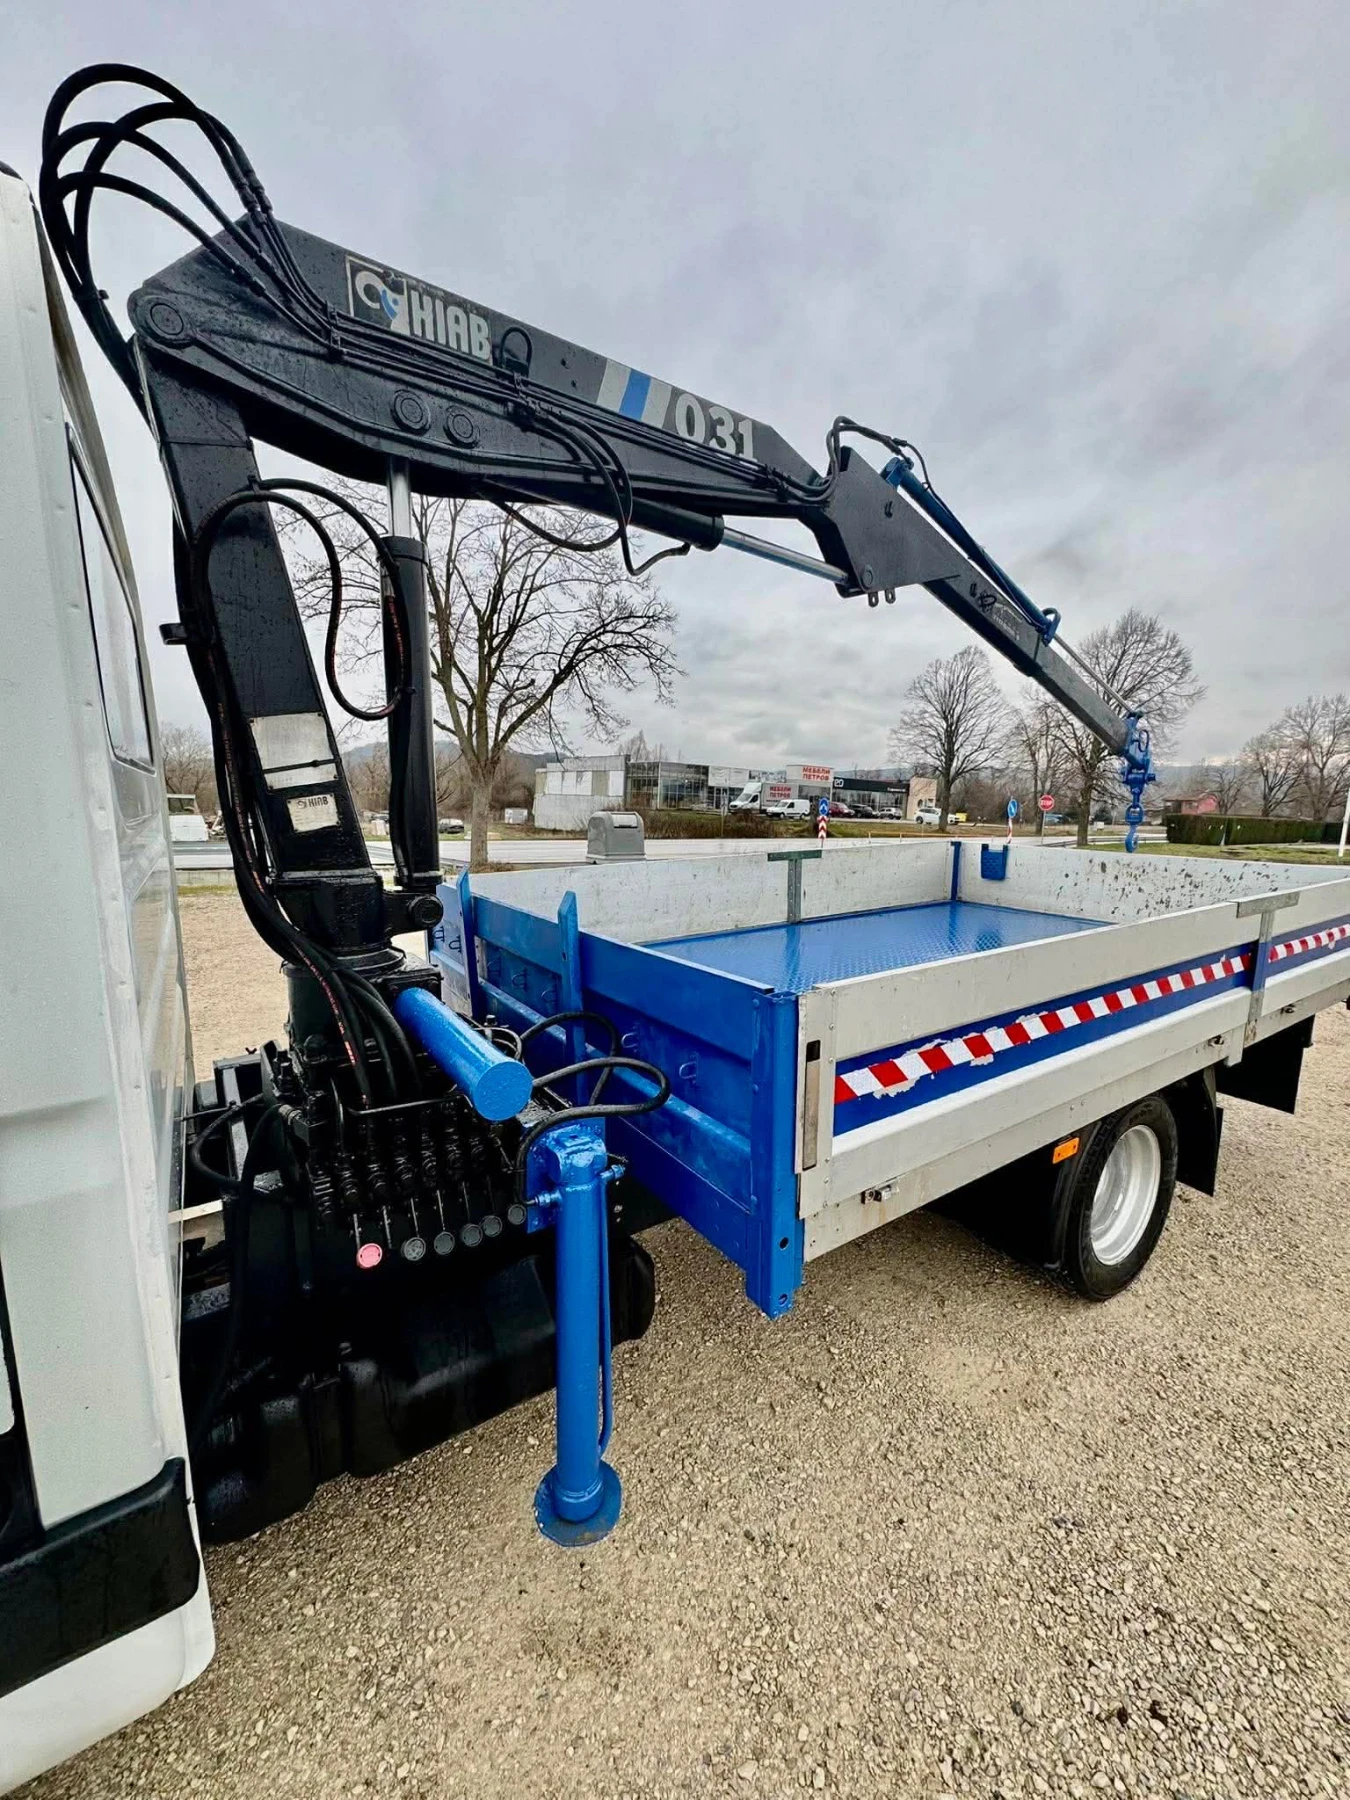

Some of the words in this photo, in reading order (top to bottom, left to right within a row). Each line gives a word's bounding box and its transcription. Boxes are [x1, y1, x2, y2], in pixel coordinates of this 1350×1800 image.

[410, 289, 491, 361] HIAB
[676, 393, 758, 469] 031
[802, 773, 830, 781] ПЕТРОВ
[307, 796, 329, 807] HIAB
